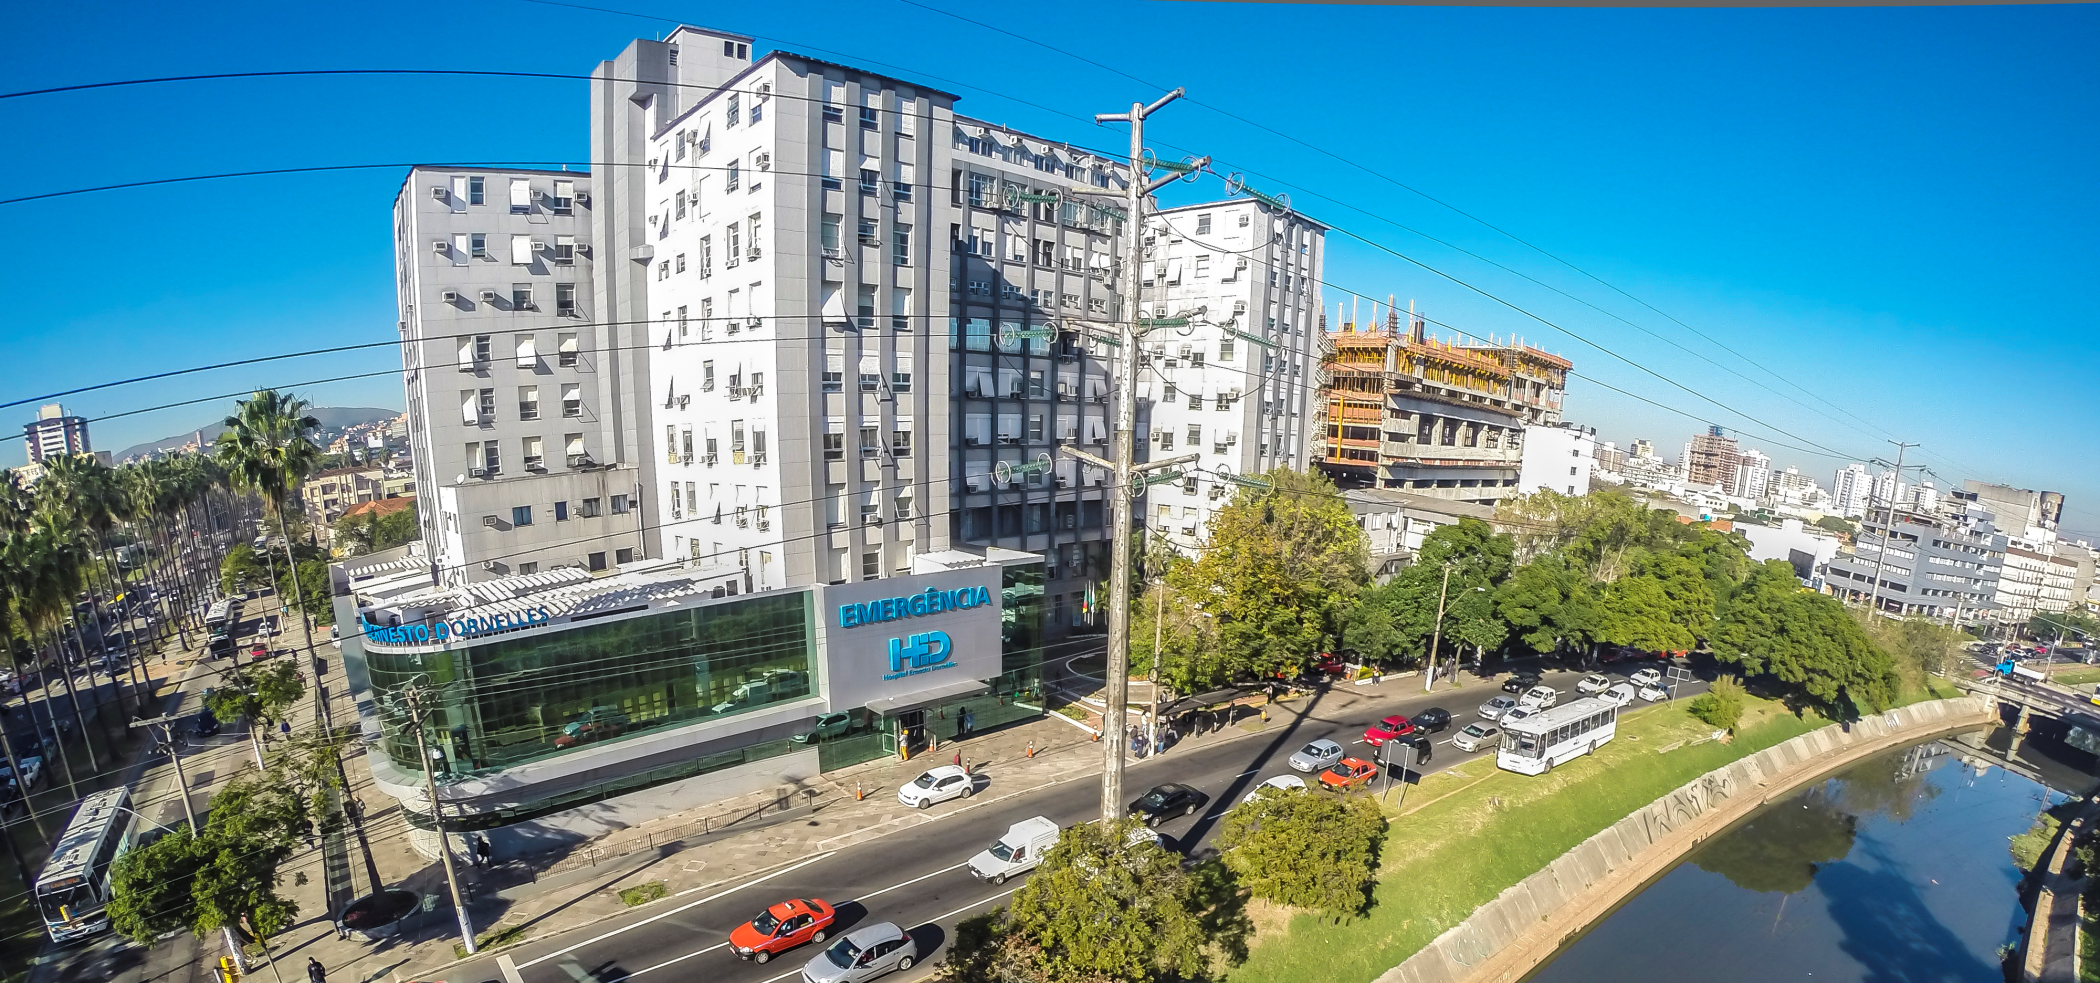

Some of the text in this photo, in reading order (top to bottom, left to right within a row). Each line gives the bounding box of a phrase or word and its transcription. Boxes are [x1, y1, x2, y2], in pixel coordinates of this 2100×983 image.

[435, 606, 548, 640] DORNELLES
[839, 586, 991, 628] EMERGÊNCIA
[882, 670, 908, 681] Hospital
